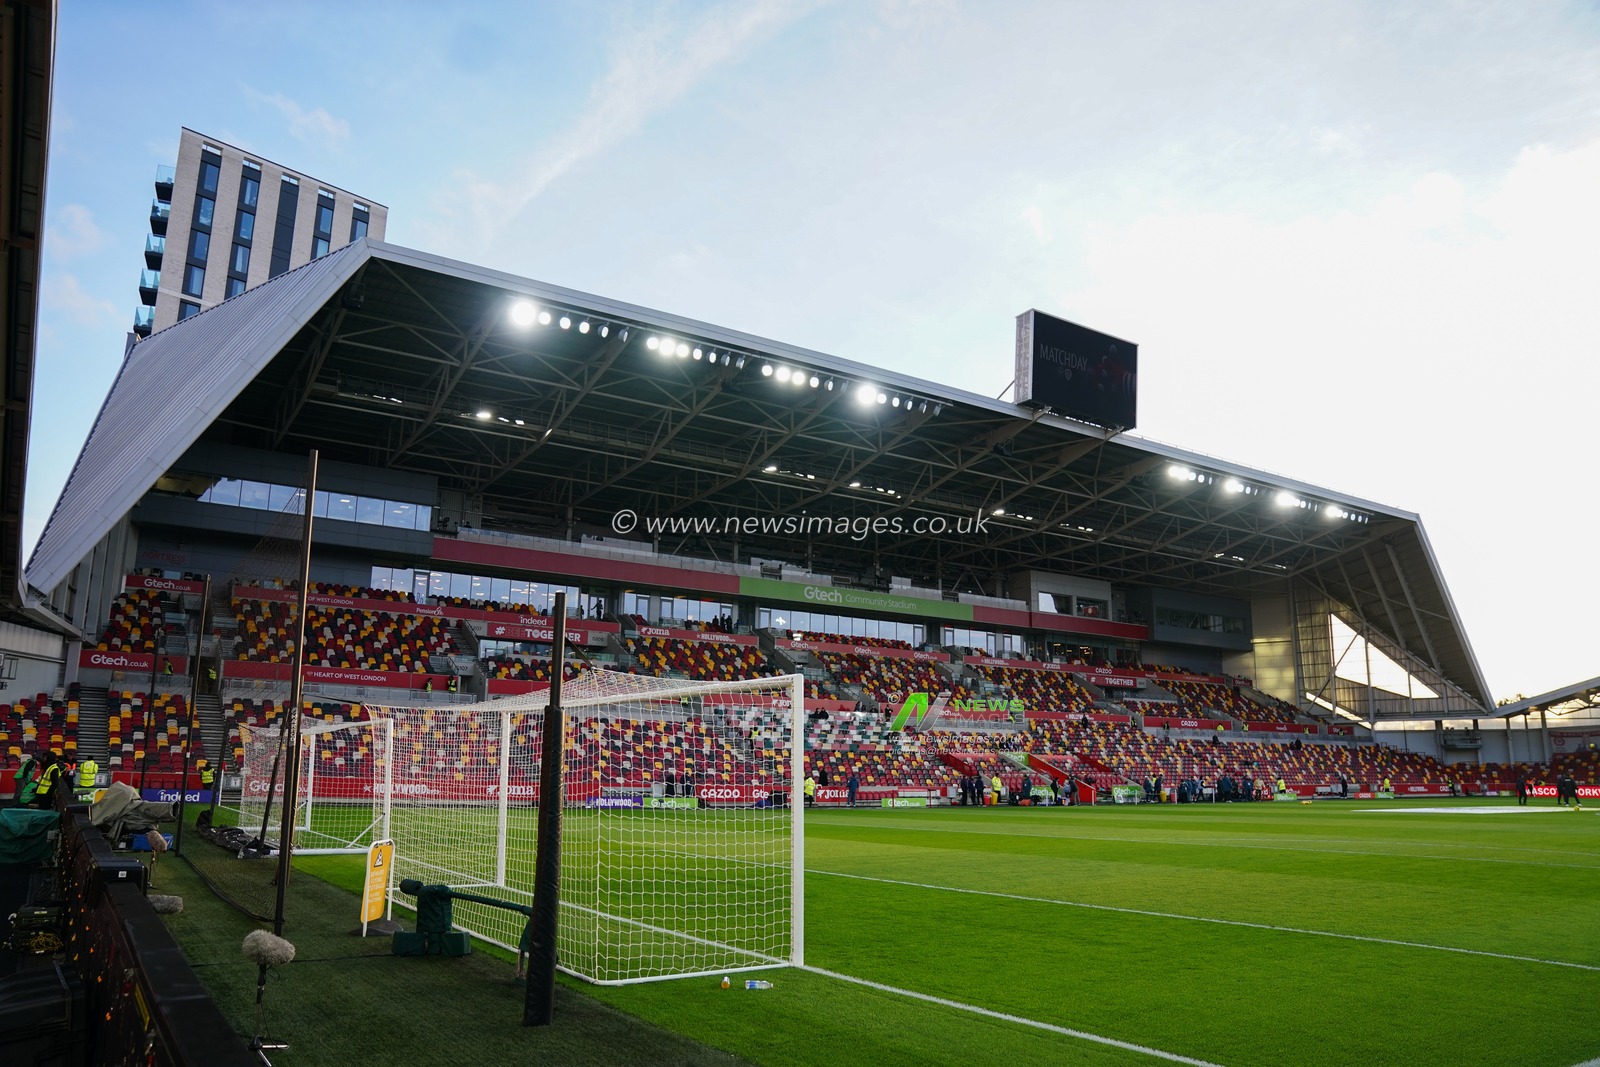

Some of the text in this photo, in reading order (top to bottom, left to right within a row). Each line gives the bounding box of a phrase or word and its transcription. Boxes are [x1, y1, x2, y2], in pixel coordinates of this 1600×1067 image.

[1040, 343, 1088, 372] MATCHDAY
[143, 551, 186, 563] FORTRESS
[144, 578, 192, 591] Gtech.co.uk
[804, 586, 917, 610] Gtech Community Stadium
[520, 615, 547, 626] indeed
[90, 654, 149, 668] Gtech.co.uk
[1105, 677, 1134, 686] TOGETHER
[700, 788, 740, 799] CAZOO
